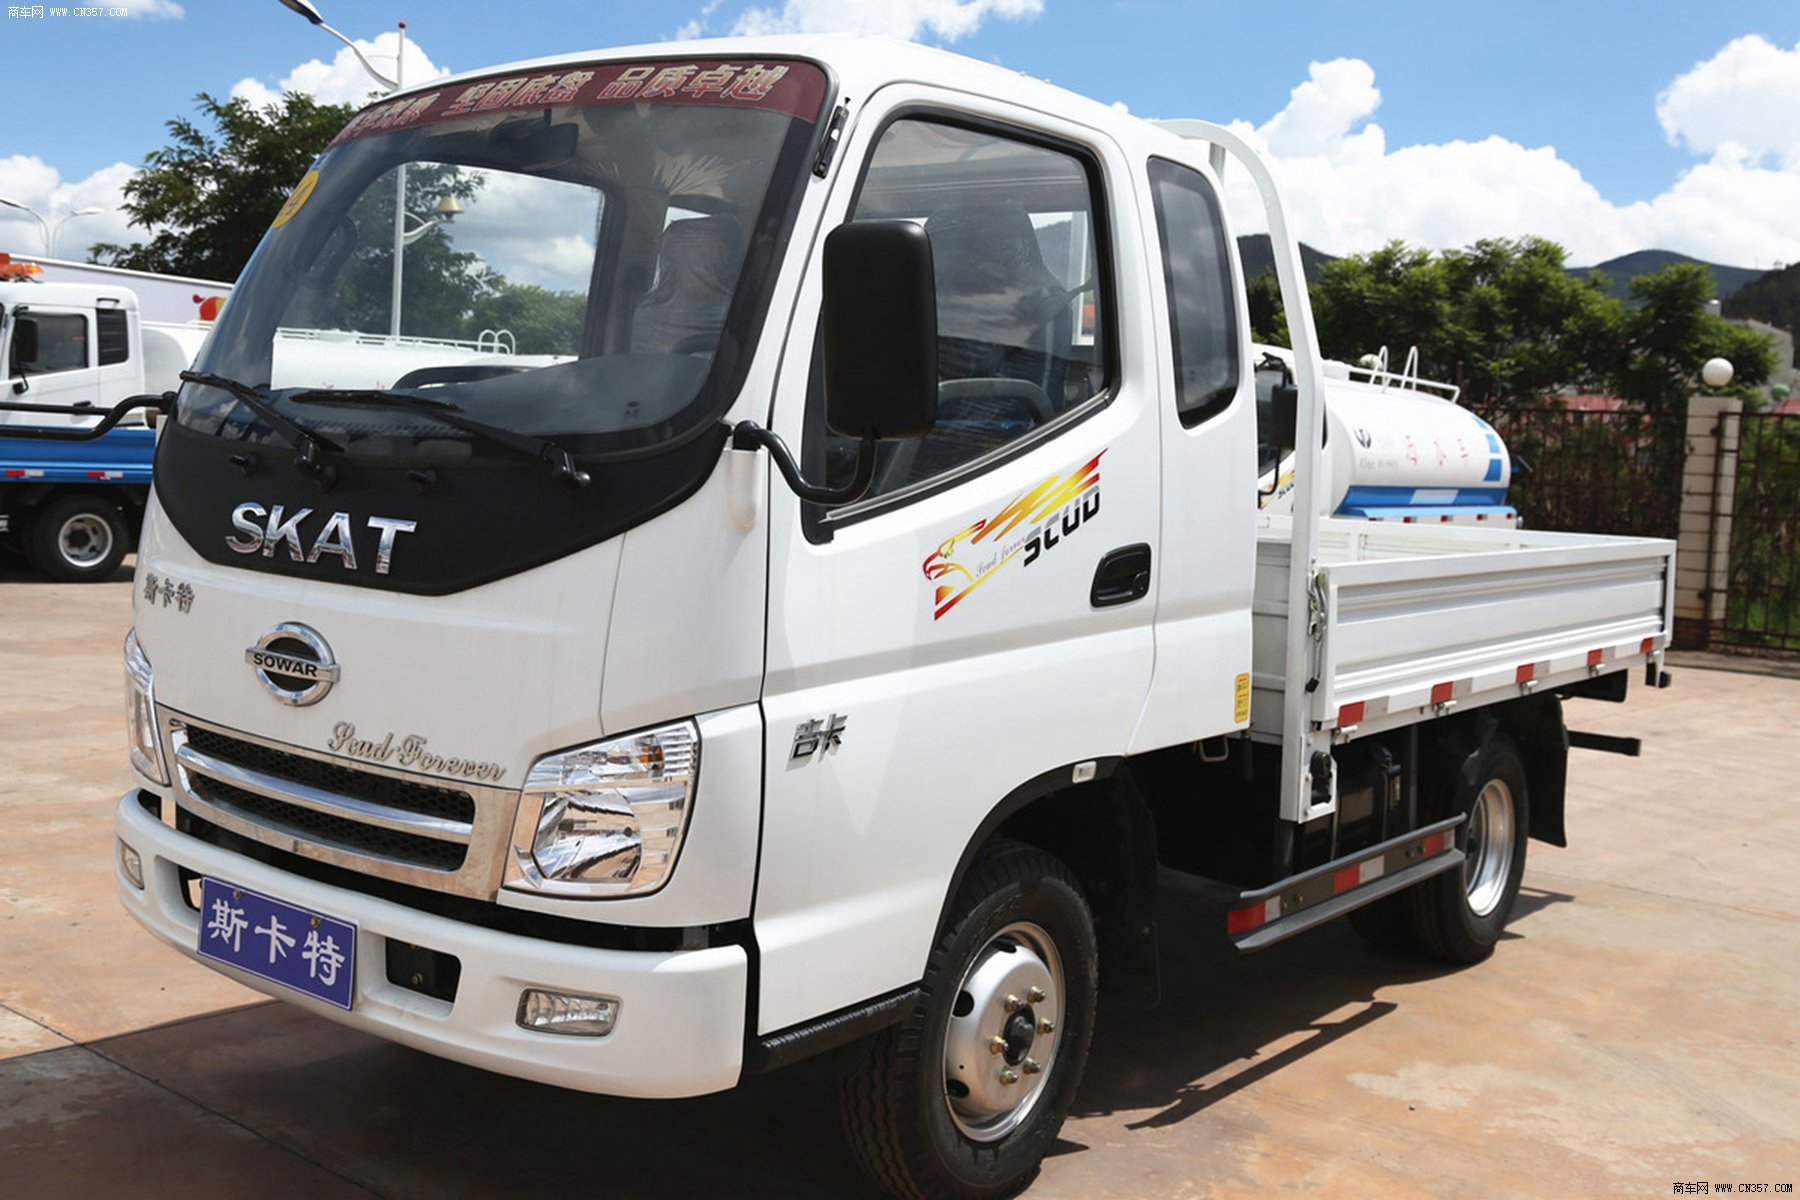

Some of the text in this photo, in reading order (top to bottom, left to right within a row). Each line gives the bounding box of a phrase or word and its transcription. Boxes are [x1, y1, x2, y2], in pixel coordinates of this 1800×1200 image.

[597, 64, 790, 101] 品质卓越
[224, 502, 418, 575] SKAT
[253, 652, 318, 678] SOWAR
[207, 898, 346, 986] 斯卡特
